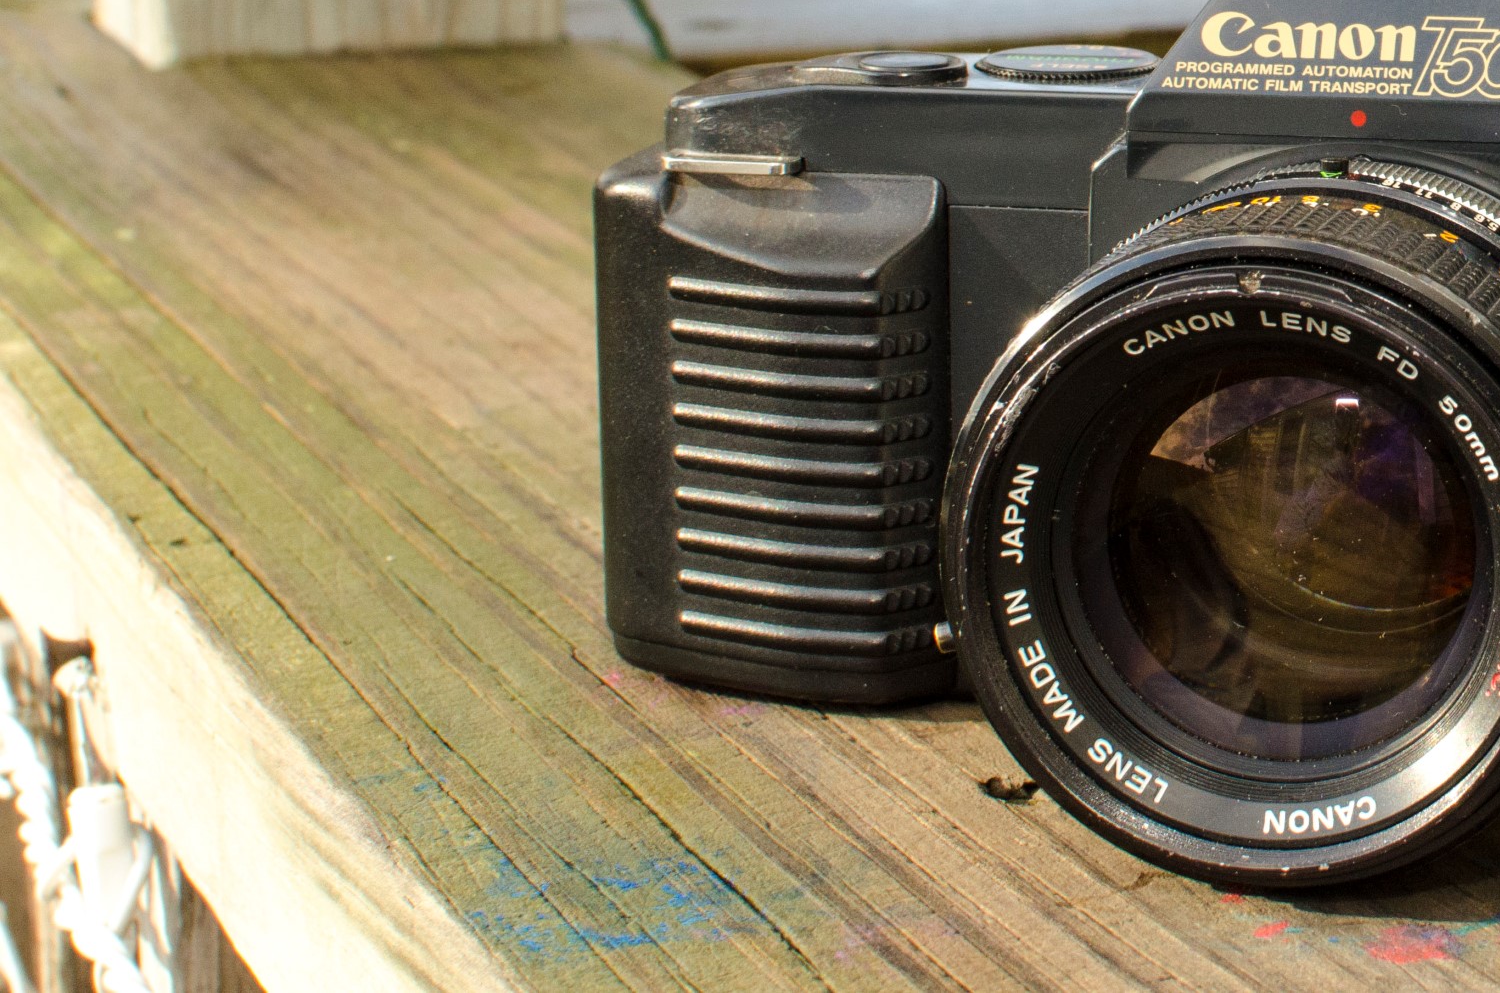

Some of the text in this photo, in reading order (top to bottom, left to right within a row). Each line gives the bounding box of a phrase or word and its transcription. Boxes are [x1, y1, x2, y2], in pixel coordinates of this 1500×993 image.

[1201, 11, 1416, 62] Canon
[1175, 61, 1413, 80] PROGRAMMED AUTOMATION
[1161, 76, 1412, 95] AUTOMATIC FILM TRANSPORT
[1382, 179, 1400, 189] 16
[1415, 187, 1433, 199] 11
[1450, 201, 1462, 212] 8
[1474, 213, 1499, 232] 5.6
[1440, 230, 1459, 243] 2
[1123, 310, 1236, 357] CANON
[1260, 310, 1353, 344] LENS
[1376, 346, 1420, 382] FD
[1438, 395, 1500, 483] 50mm
[1001, 463, 1378, 836] CANON LENS MADE IN JAPAN
